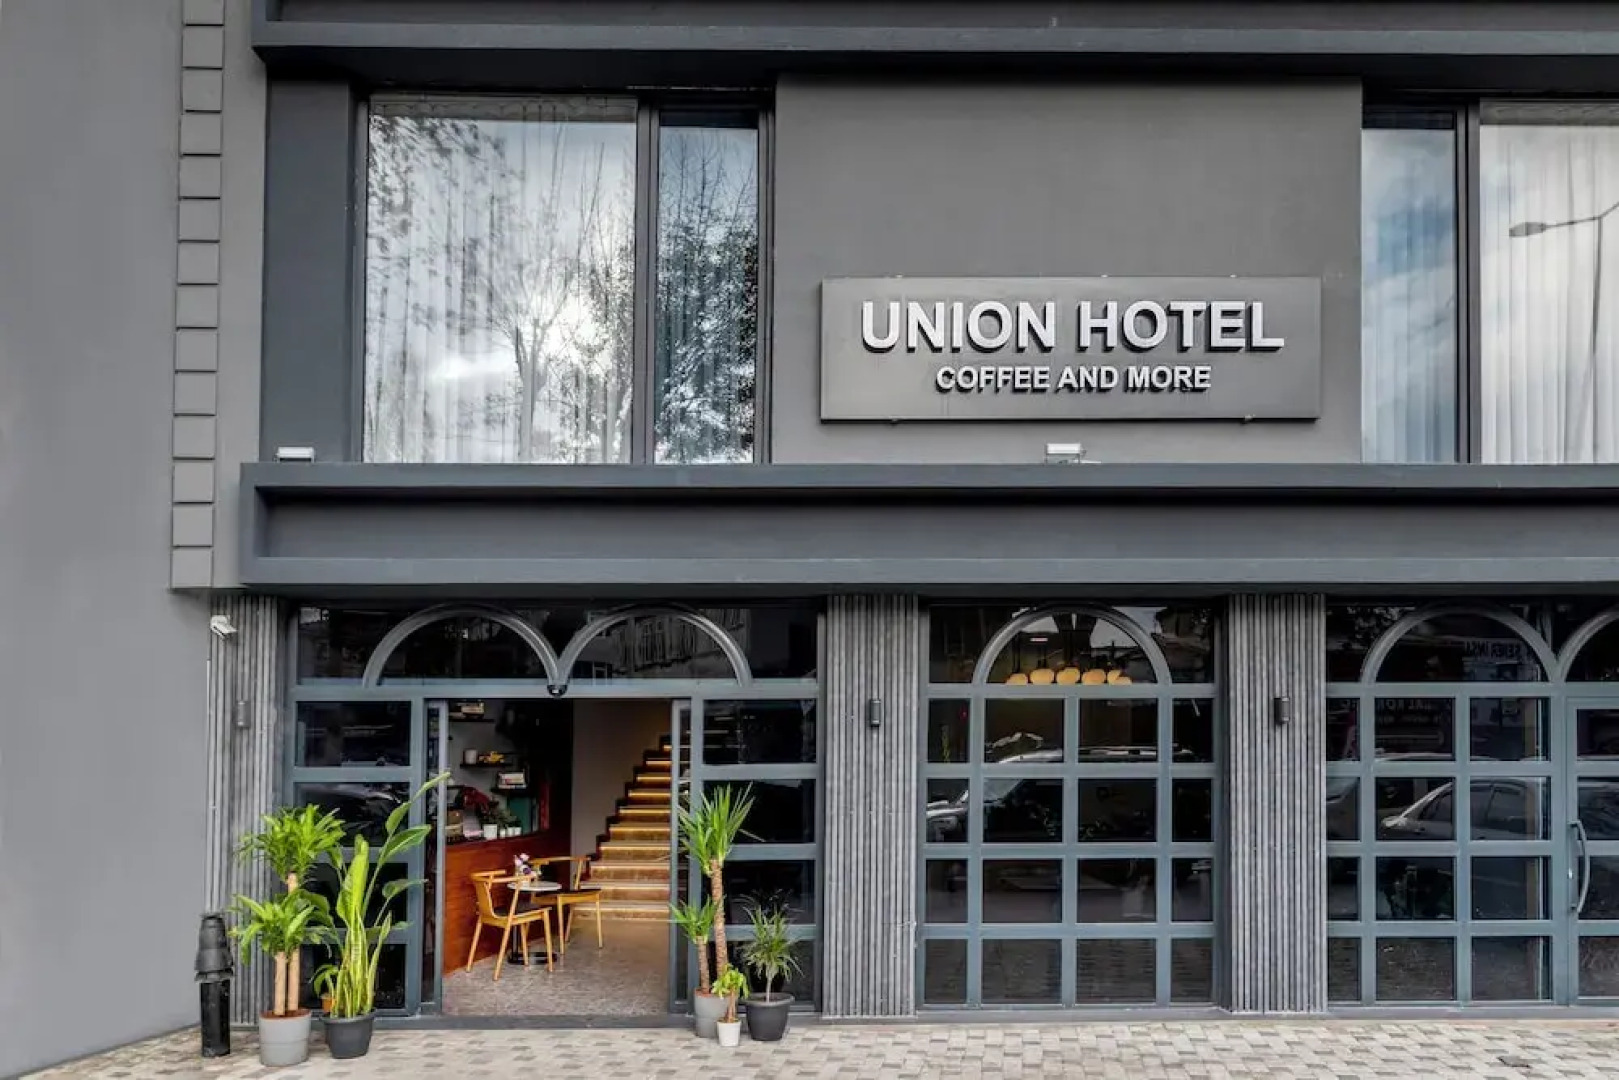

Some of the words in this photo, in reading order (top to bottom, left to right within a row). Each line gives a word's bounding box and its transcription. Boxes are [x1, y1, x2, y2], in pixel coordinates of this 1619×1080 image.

[862, 300, 1055, 351] UNION
[1077, 300, 1285, 351] HOTEL
[935, 365, 1050, 391] COFFEE
[1056, 365, 1119, 391] AND
[1125, 365, 1212, 391] MORE
